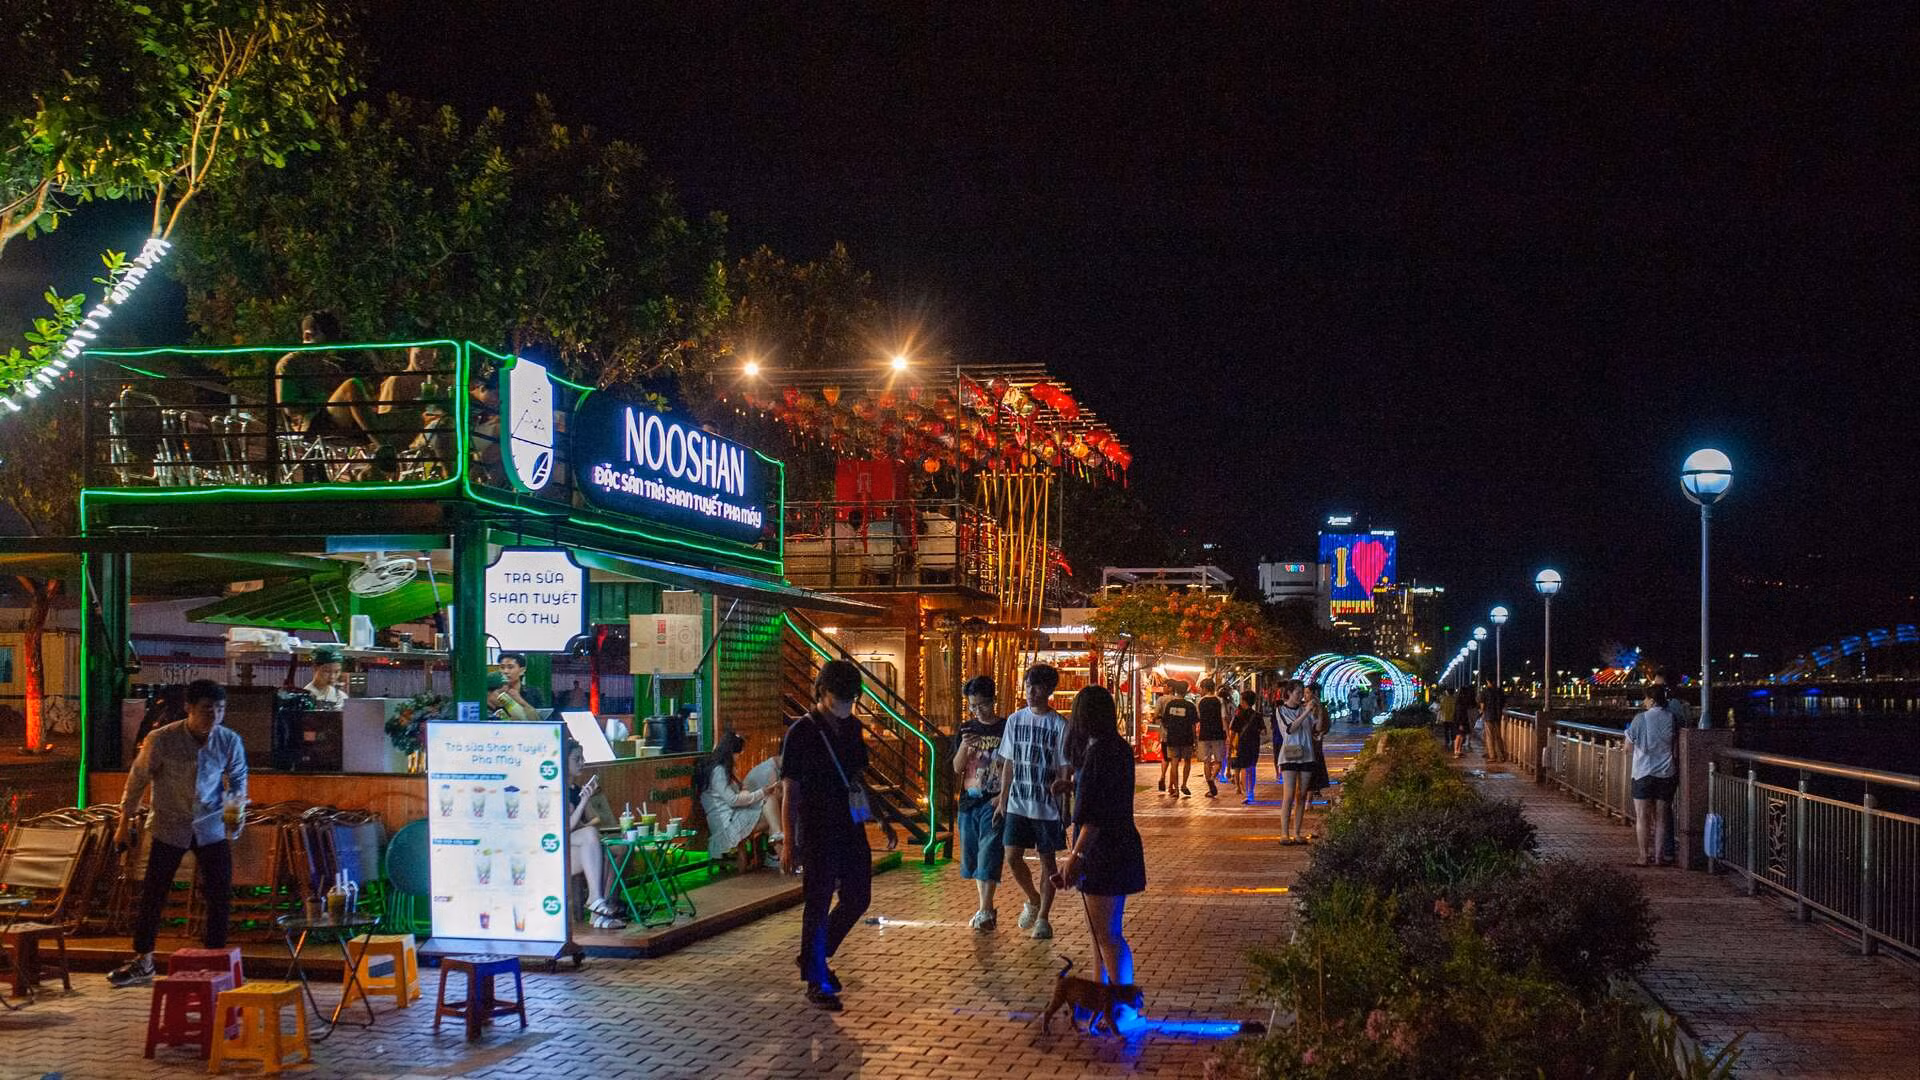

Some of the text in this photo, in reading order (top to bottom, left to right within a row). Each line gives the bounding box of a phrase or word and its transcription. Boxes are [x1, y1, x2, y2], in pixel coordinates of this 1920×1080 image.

[625, 406, 744, 497] NOOSHAN
[723, 503, 741, 522] PHA
[489, 592, 529, 604] SHAN
